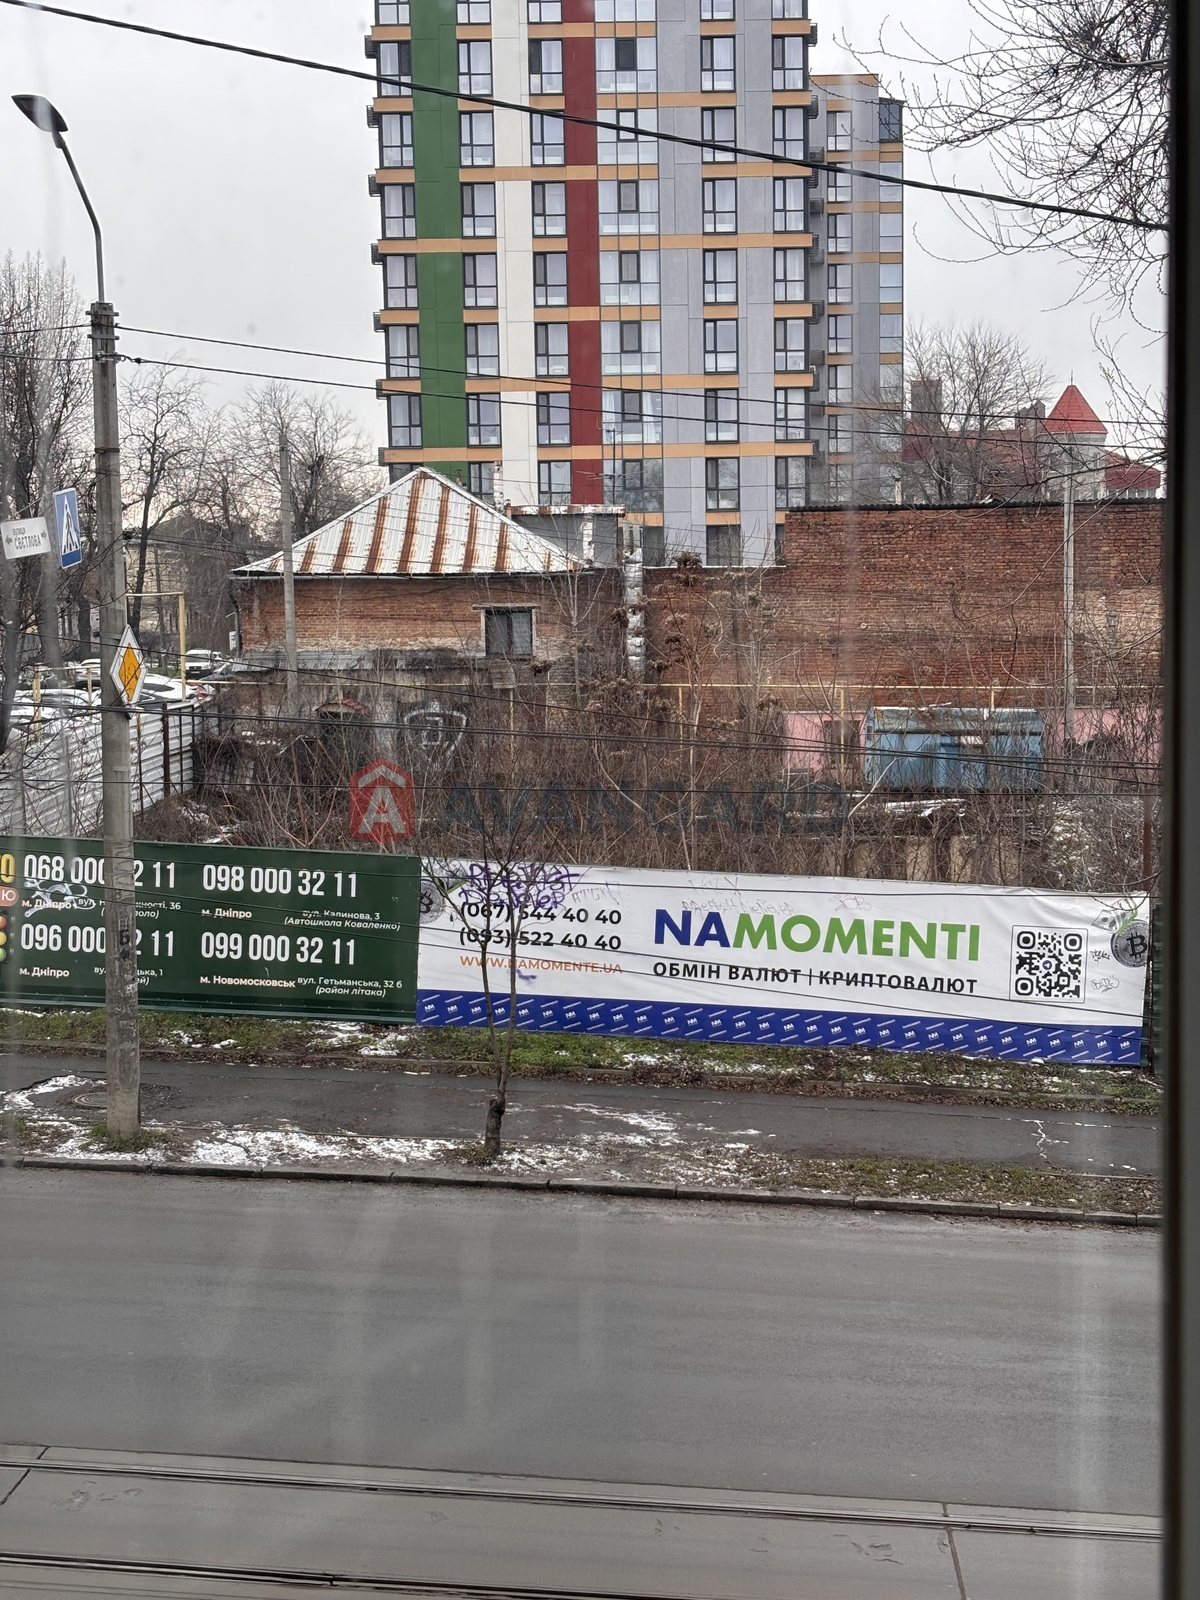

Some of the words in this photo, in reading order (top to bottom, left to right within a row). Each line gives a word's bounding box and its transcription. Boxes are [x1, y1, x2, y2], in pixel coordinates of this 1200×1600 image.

[24, 854, 65, 882] 068
[203, 864, 244, 892] 098
[250, 867, 292, 894] 000
[298, 869, 325, 896] 32
[169, 902, 181, 910] 36
[201, 908, 213, 917] м.
[214, 907, 252, 919] Дніпро
[323, 910, 373, 922] Калинова,
[374, 912, 381, 921] 3
[284, 916, 342, 928] (Автошкола
[344, 920, 401, 932] Коваленко)
[562, 908, 589, 923] 40
[595, 909, 622, 925] 40
[20, 923, 62, 951] 096
[67, 925, 106, 954] 000
[518, 930, 554, 946] 522
[560, 933, 588, 948] 40
[594, 935, 622, 950] 40
[654, 908, 980, 962] NAMOMENTI
[201, 931, 243, 960] 099
[248, 934, 290, 962] 000
[296, 936, 323, 964] 32
[32, 967, 70, 978] Дніпро
[653, 961, 721, 980] ОБМІН
[728, 965, 801, 984] ВАЛЮТ
[819, 970, 978, 994] КРИПТОВАЛЮТ
[200, 977, 211, 985] м.
[213, 975, 296, 988] Новомосковськ
[297, 977, 317, 985] вул.
[318, 977, 382, 989] Гетьманська,
[383, 980, 394, 988] 32
[315, 986, 350, 995] (район
[351, 987, 387, 998] літака)
